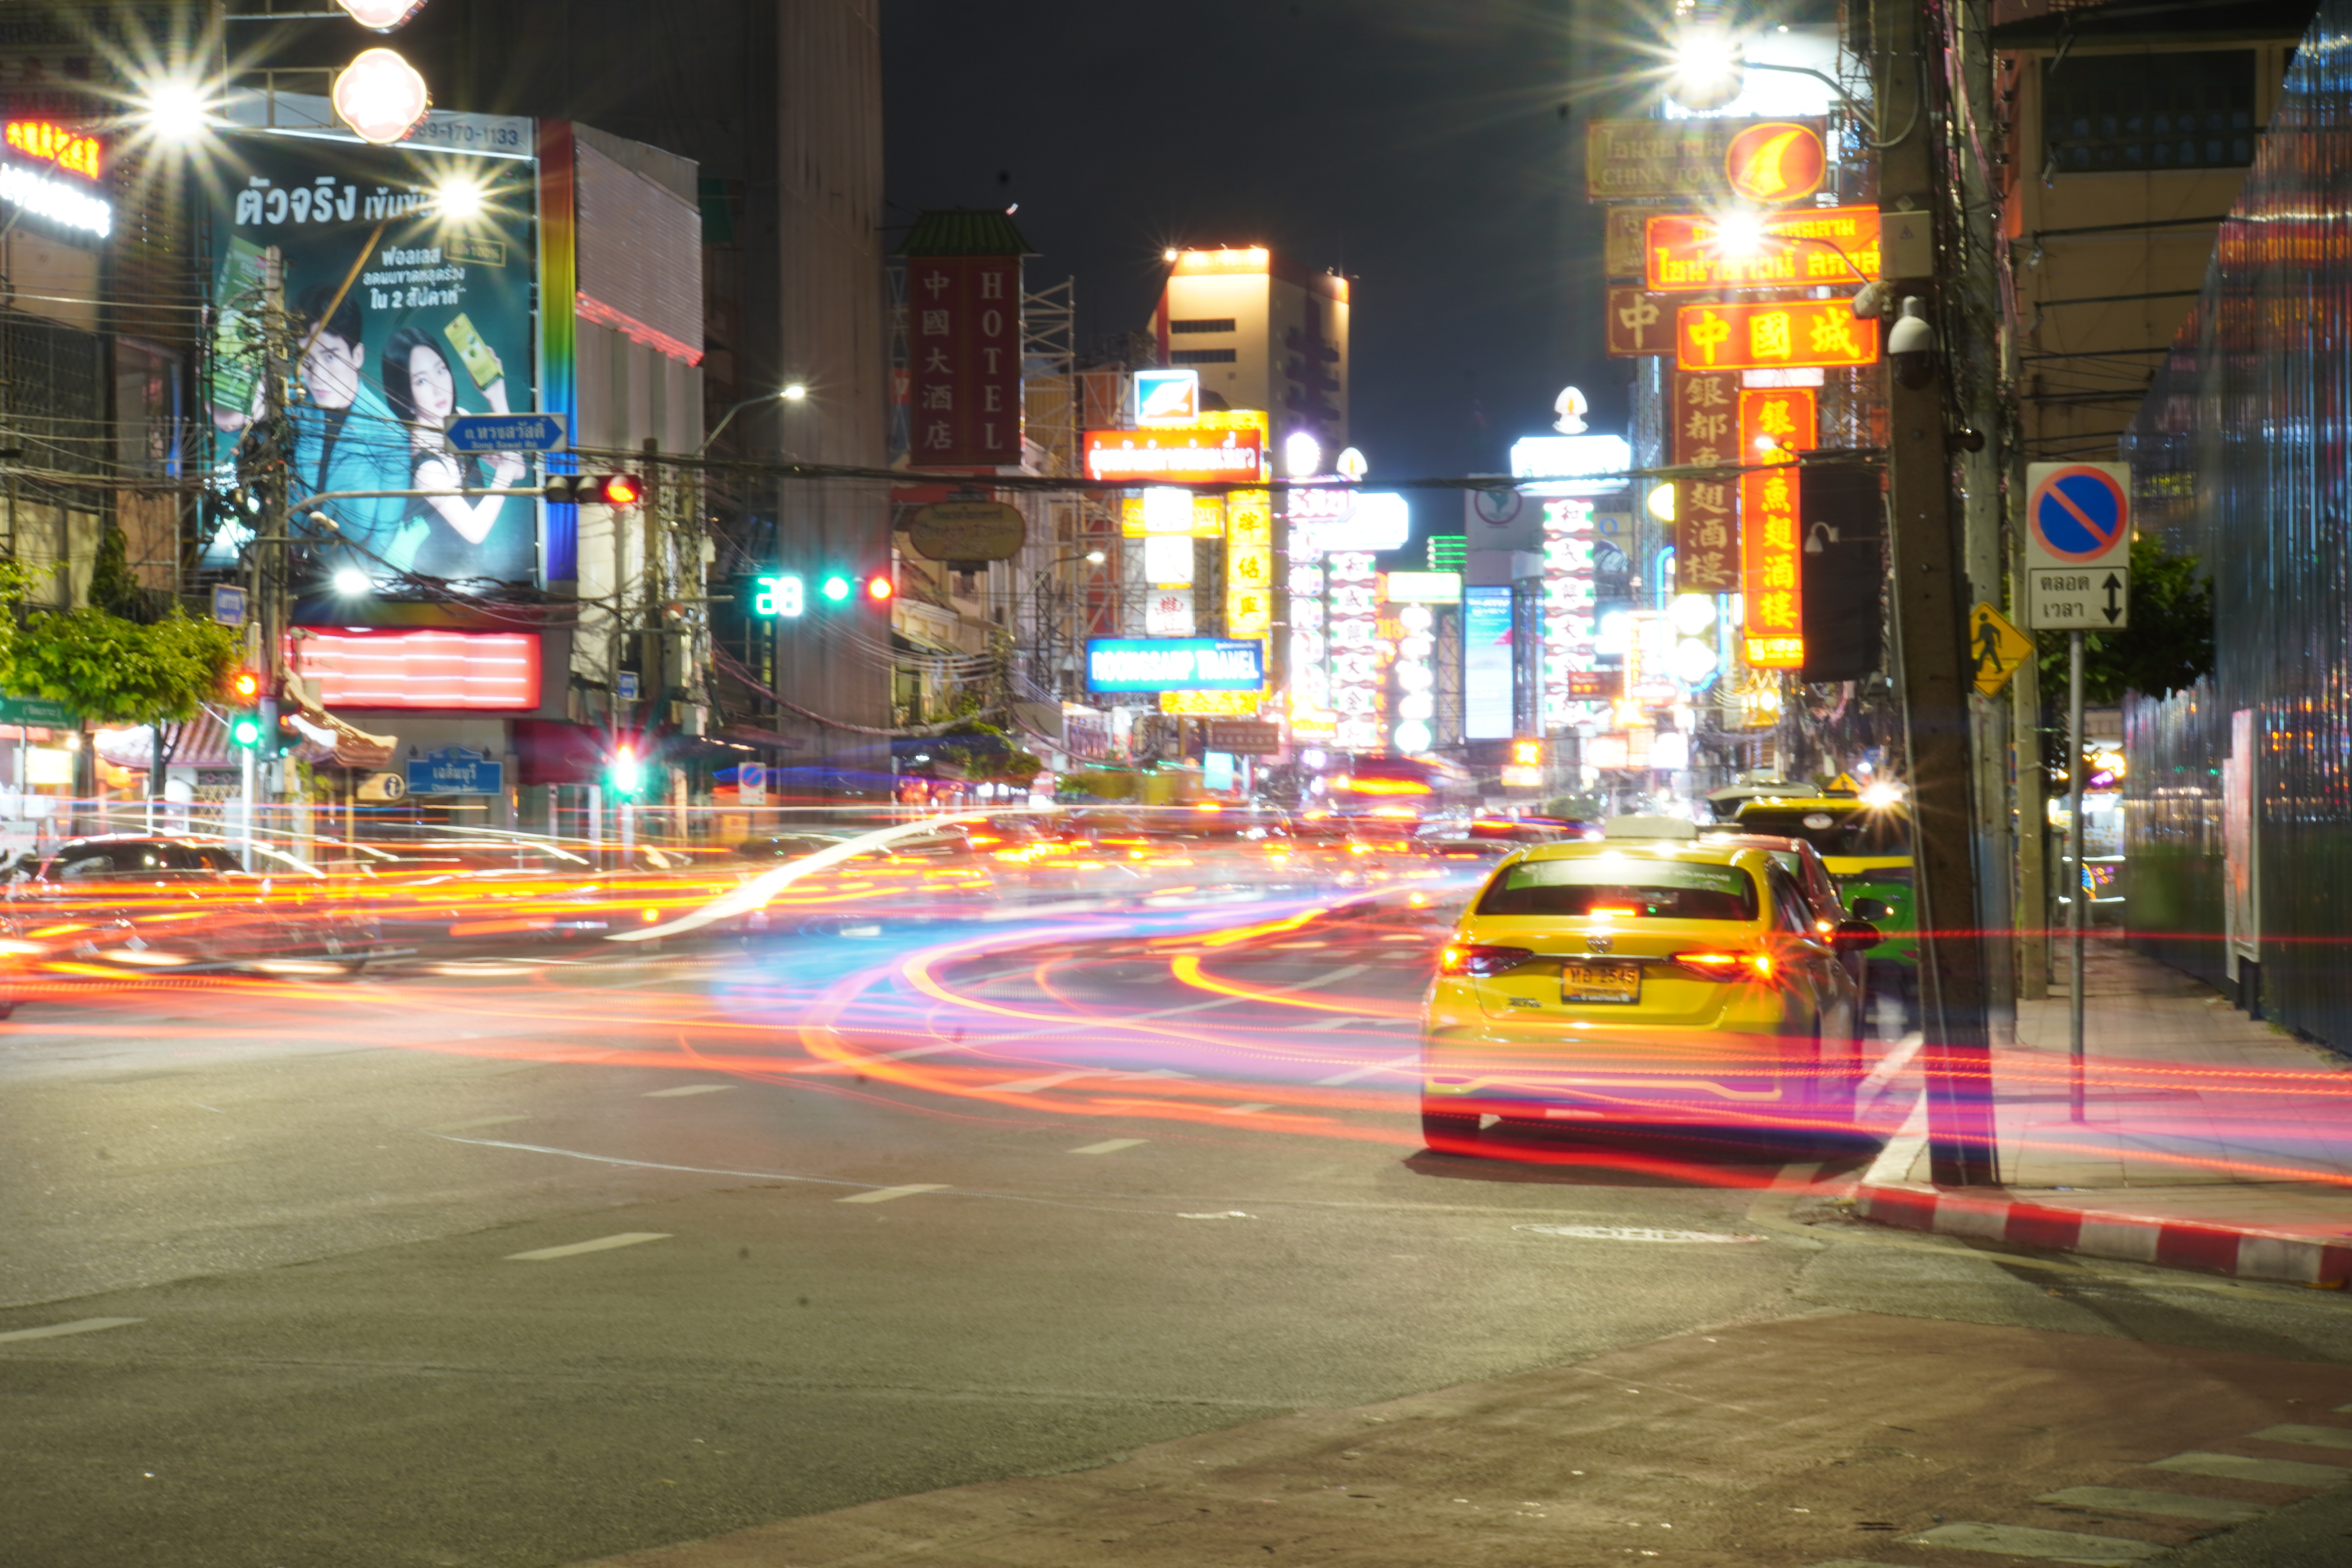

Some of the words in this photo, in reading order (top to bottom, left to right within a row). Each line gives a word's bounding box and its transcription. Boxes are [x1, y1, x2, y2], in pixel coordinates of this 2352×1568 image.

[236, 176, 356, 225] ตัวจริง
[370, 287, 388, 310] ใน
[392, 290, 403, 309] 2
[406, 283, 467, 307] สัปดาห์
[1688, 306, 1861, 365] 中國城
[922, 270, 954, 451] 中國大酒店
[981, 271, 1003, 450] HOTEL
[2040, 575, 2090, 592] ตลอด
[2043, 602, 2084, 619] เวลา
[1196, 650, 1259, 680] TRAVEL
